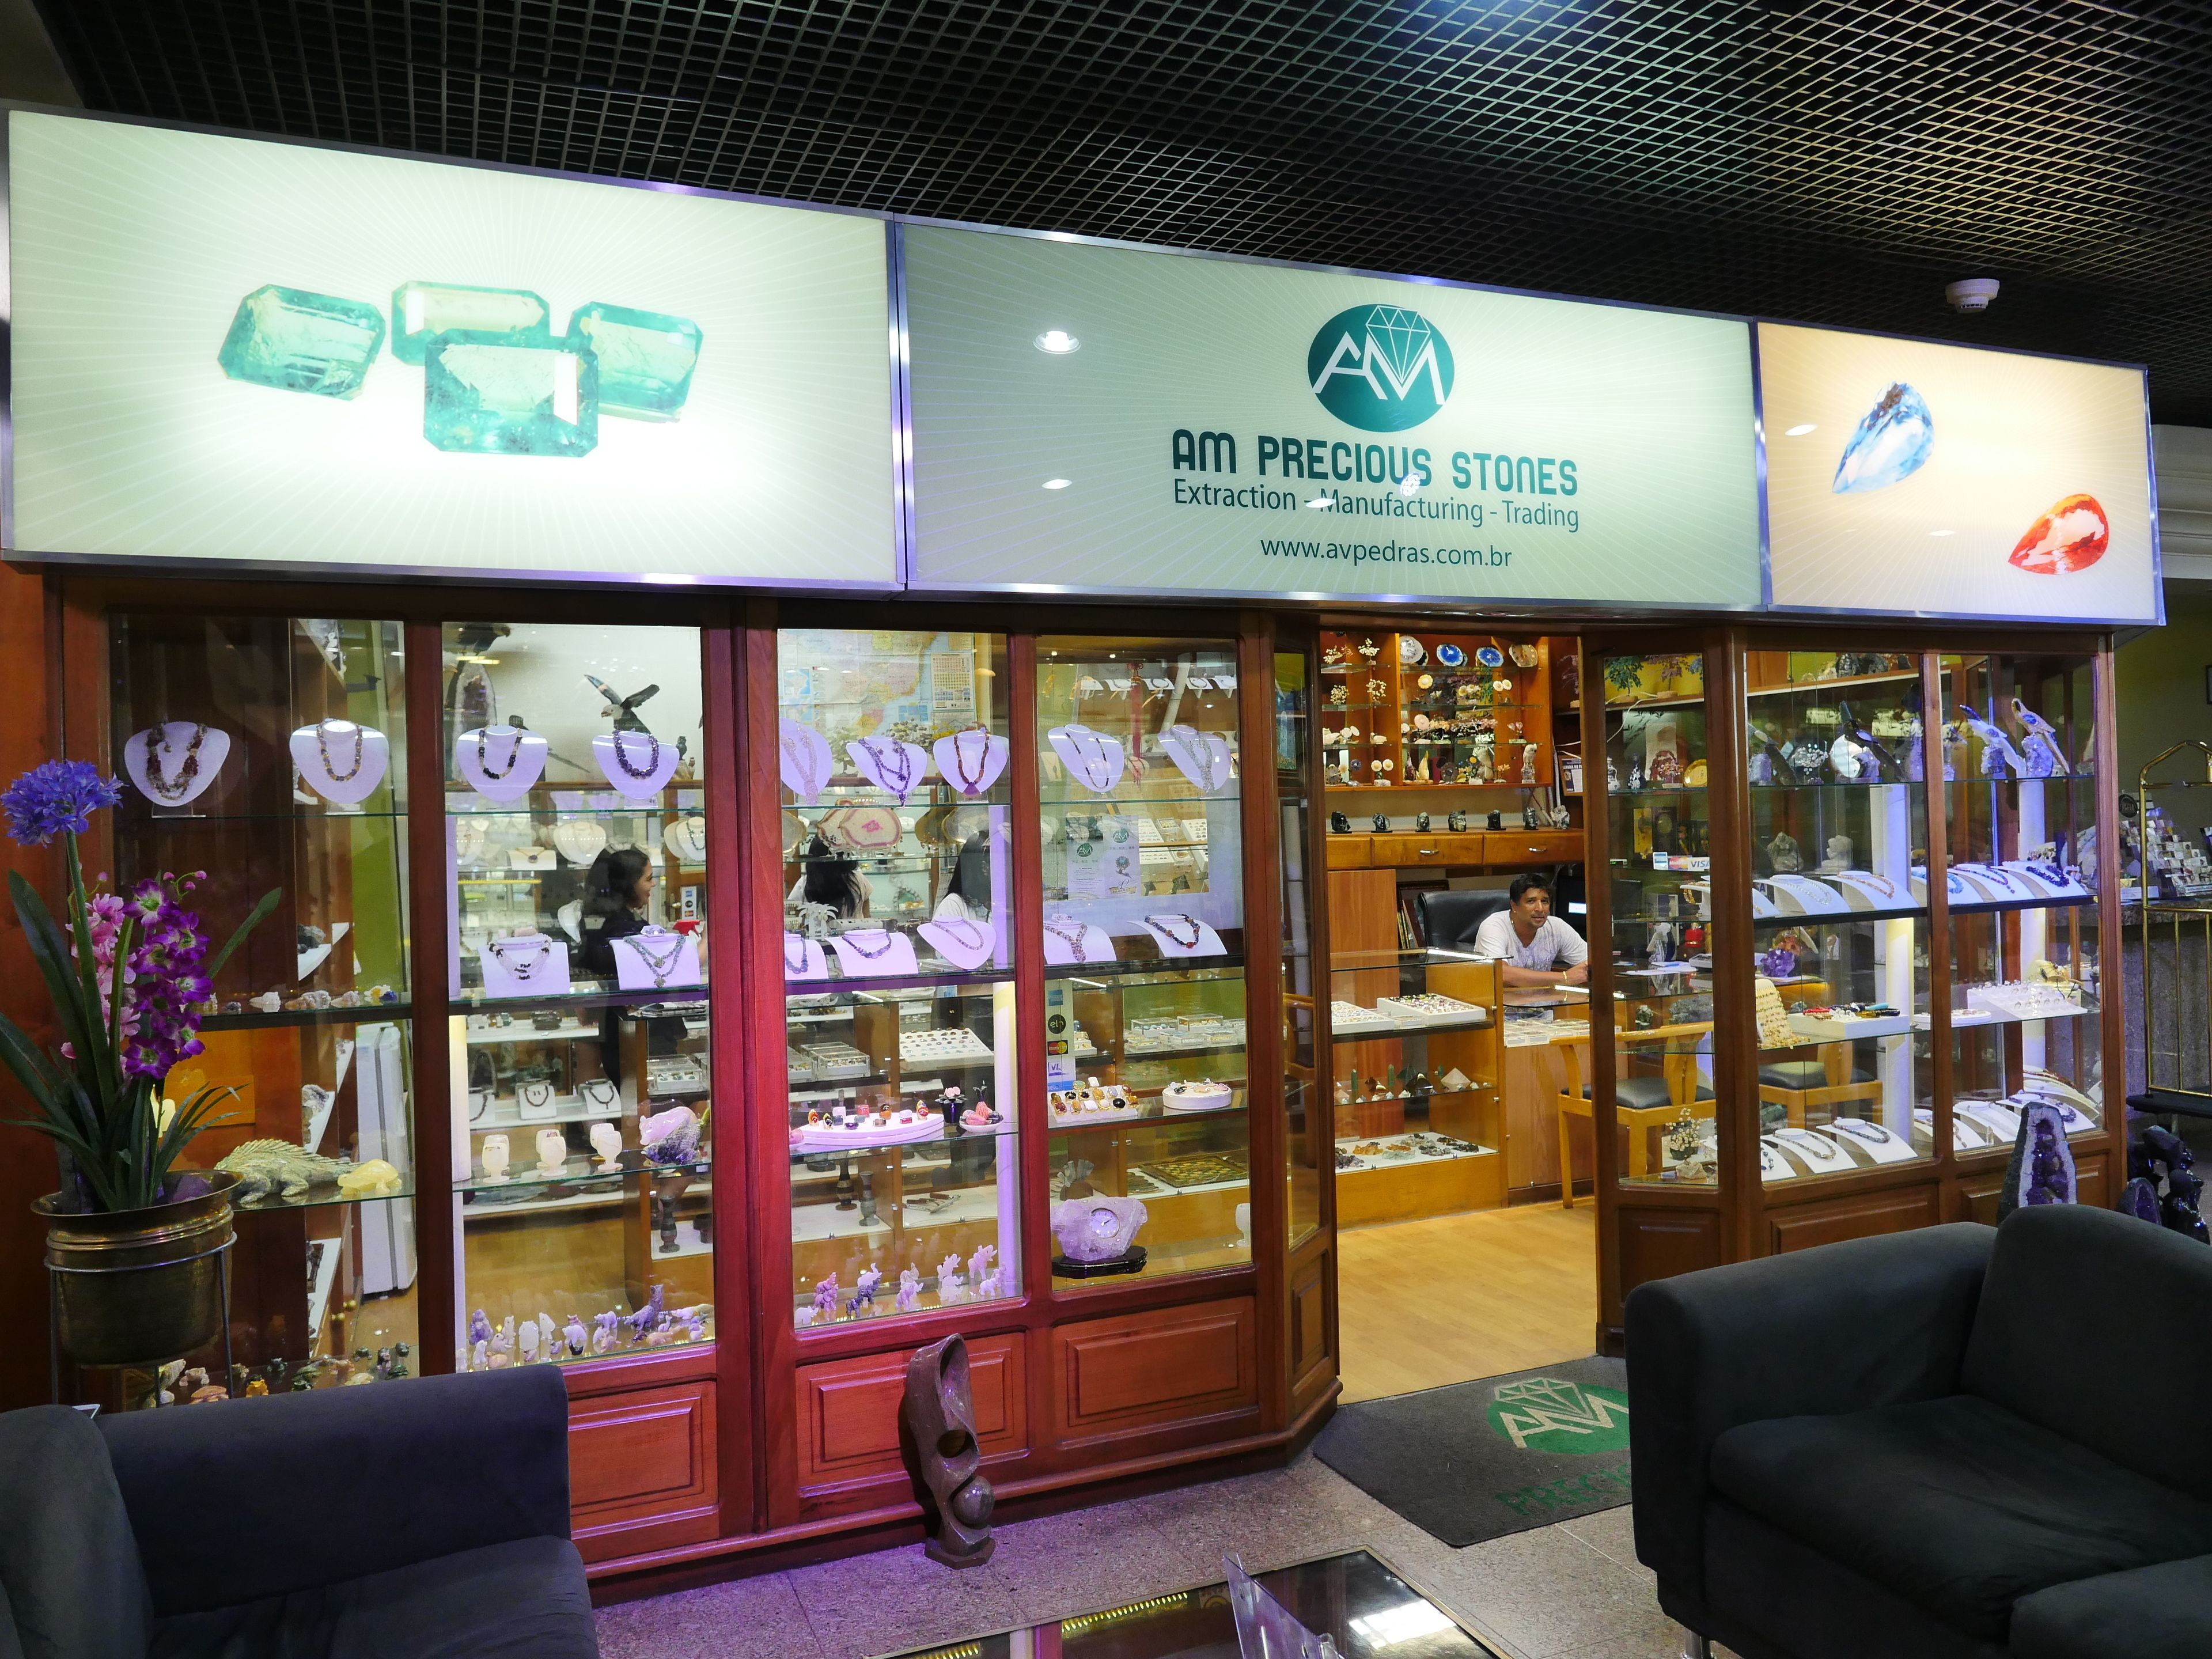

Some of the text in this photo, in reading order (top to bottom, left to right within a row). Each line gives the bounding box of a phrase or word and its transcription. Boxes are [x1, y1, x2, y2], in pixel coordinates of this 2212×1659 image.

[1312, 330, 1446, 406] AM
[1172, 429, 1578, 496] AM PRECIOUS STONES
[1174, 478, 1296, 511] Extraction
[1320, 488, 1483, 528] Manufacturing
[1501, 499, 1579, 533] Trading
[1260, 539, 1513, 567] www.avpedras.com.br
